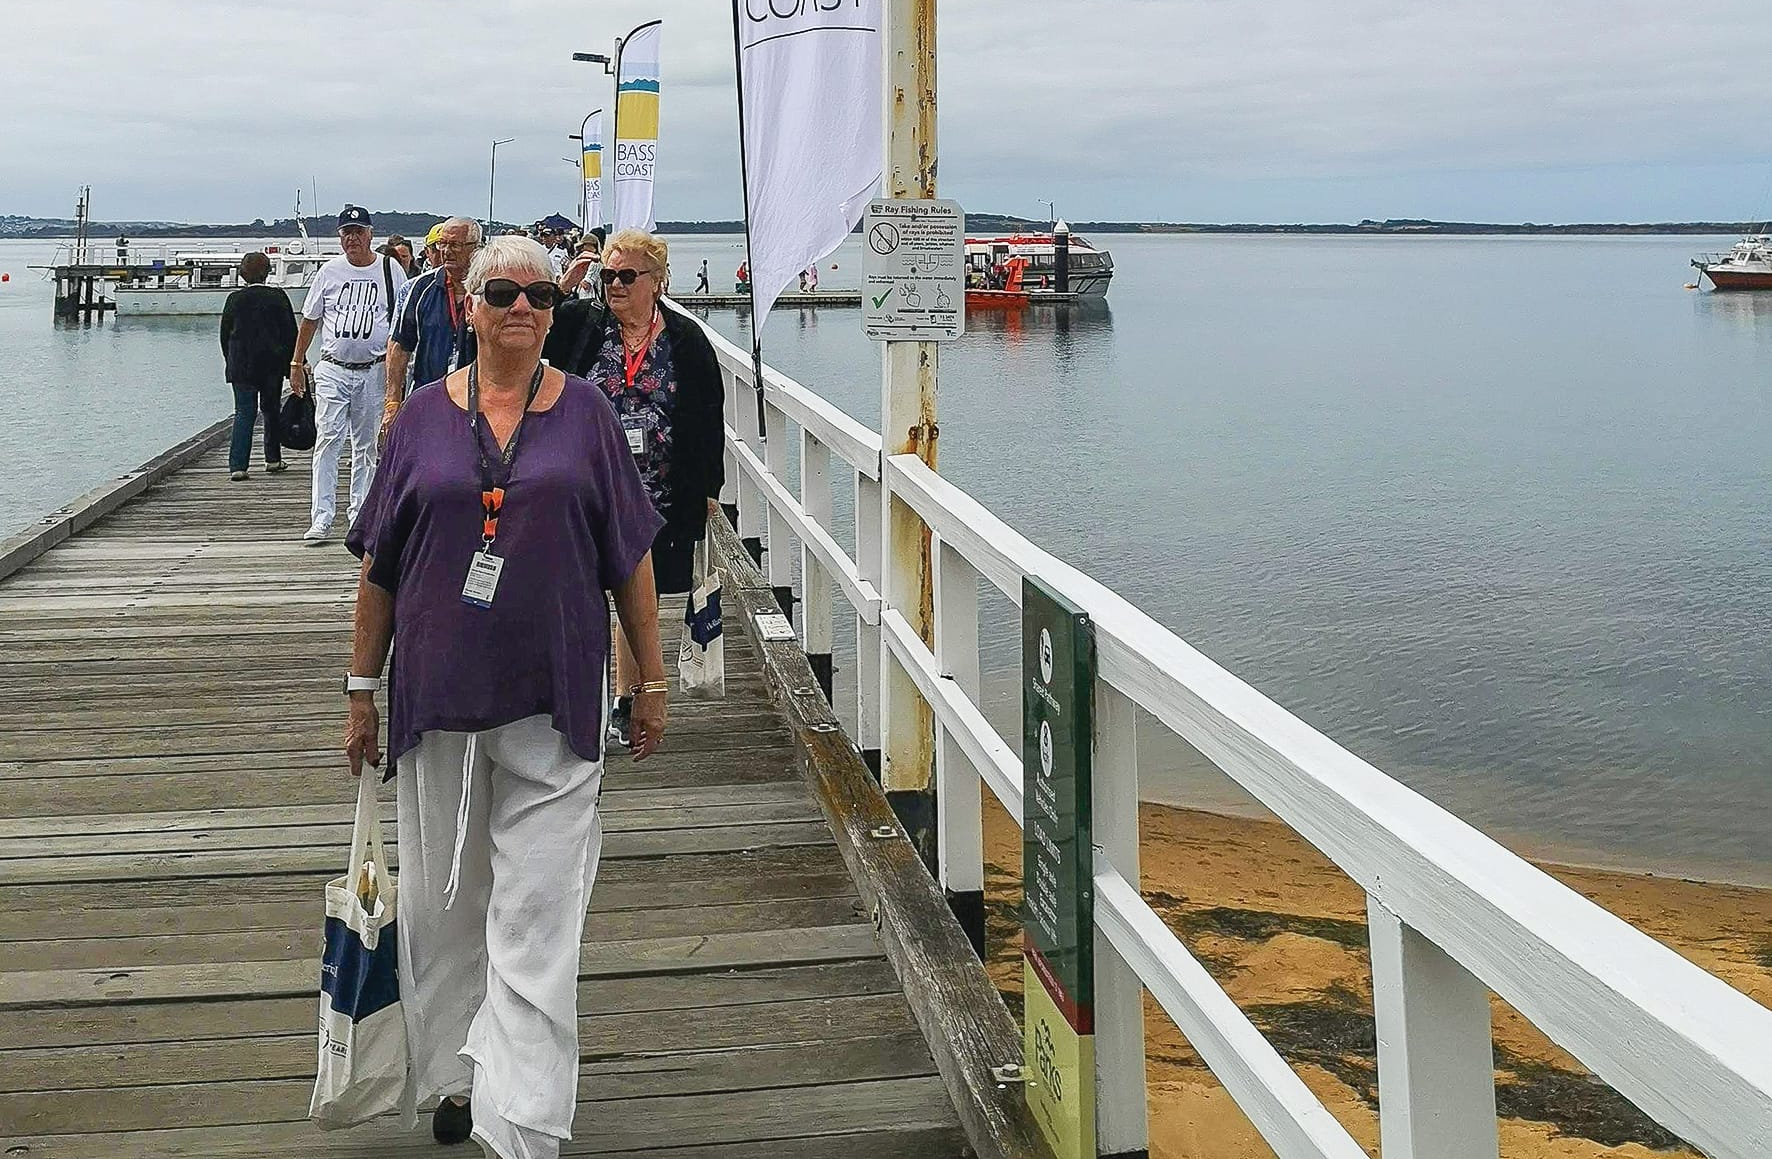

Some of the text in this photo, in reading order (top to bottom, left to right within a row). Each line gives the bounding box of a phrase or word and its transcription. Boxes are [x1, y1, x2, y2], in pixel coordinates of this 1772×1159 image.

[617, 144, 655, 161] BASS
[617, 163, 654, 176] COAST
[884, 206, 952, 215] Ray Fishing Rules
[334, 282, 378, 339] CLUB
